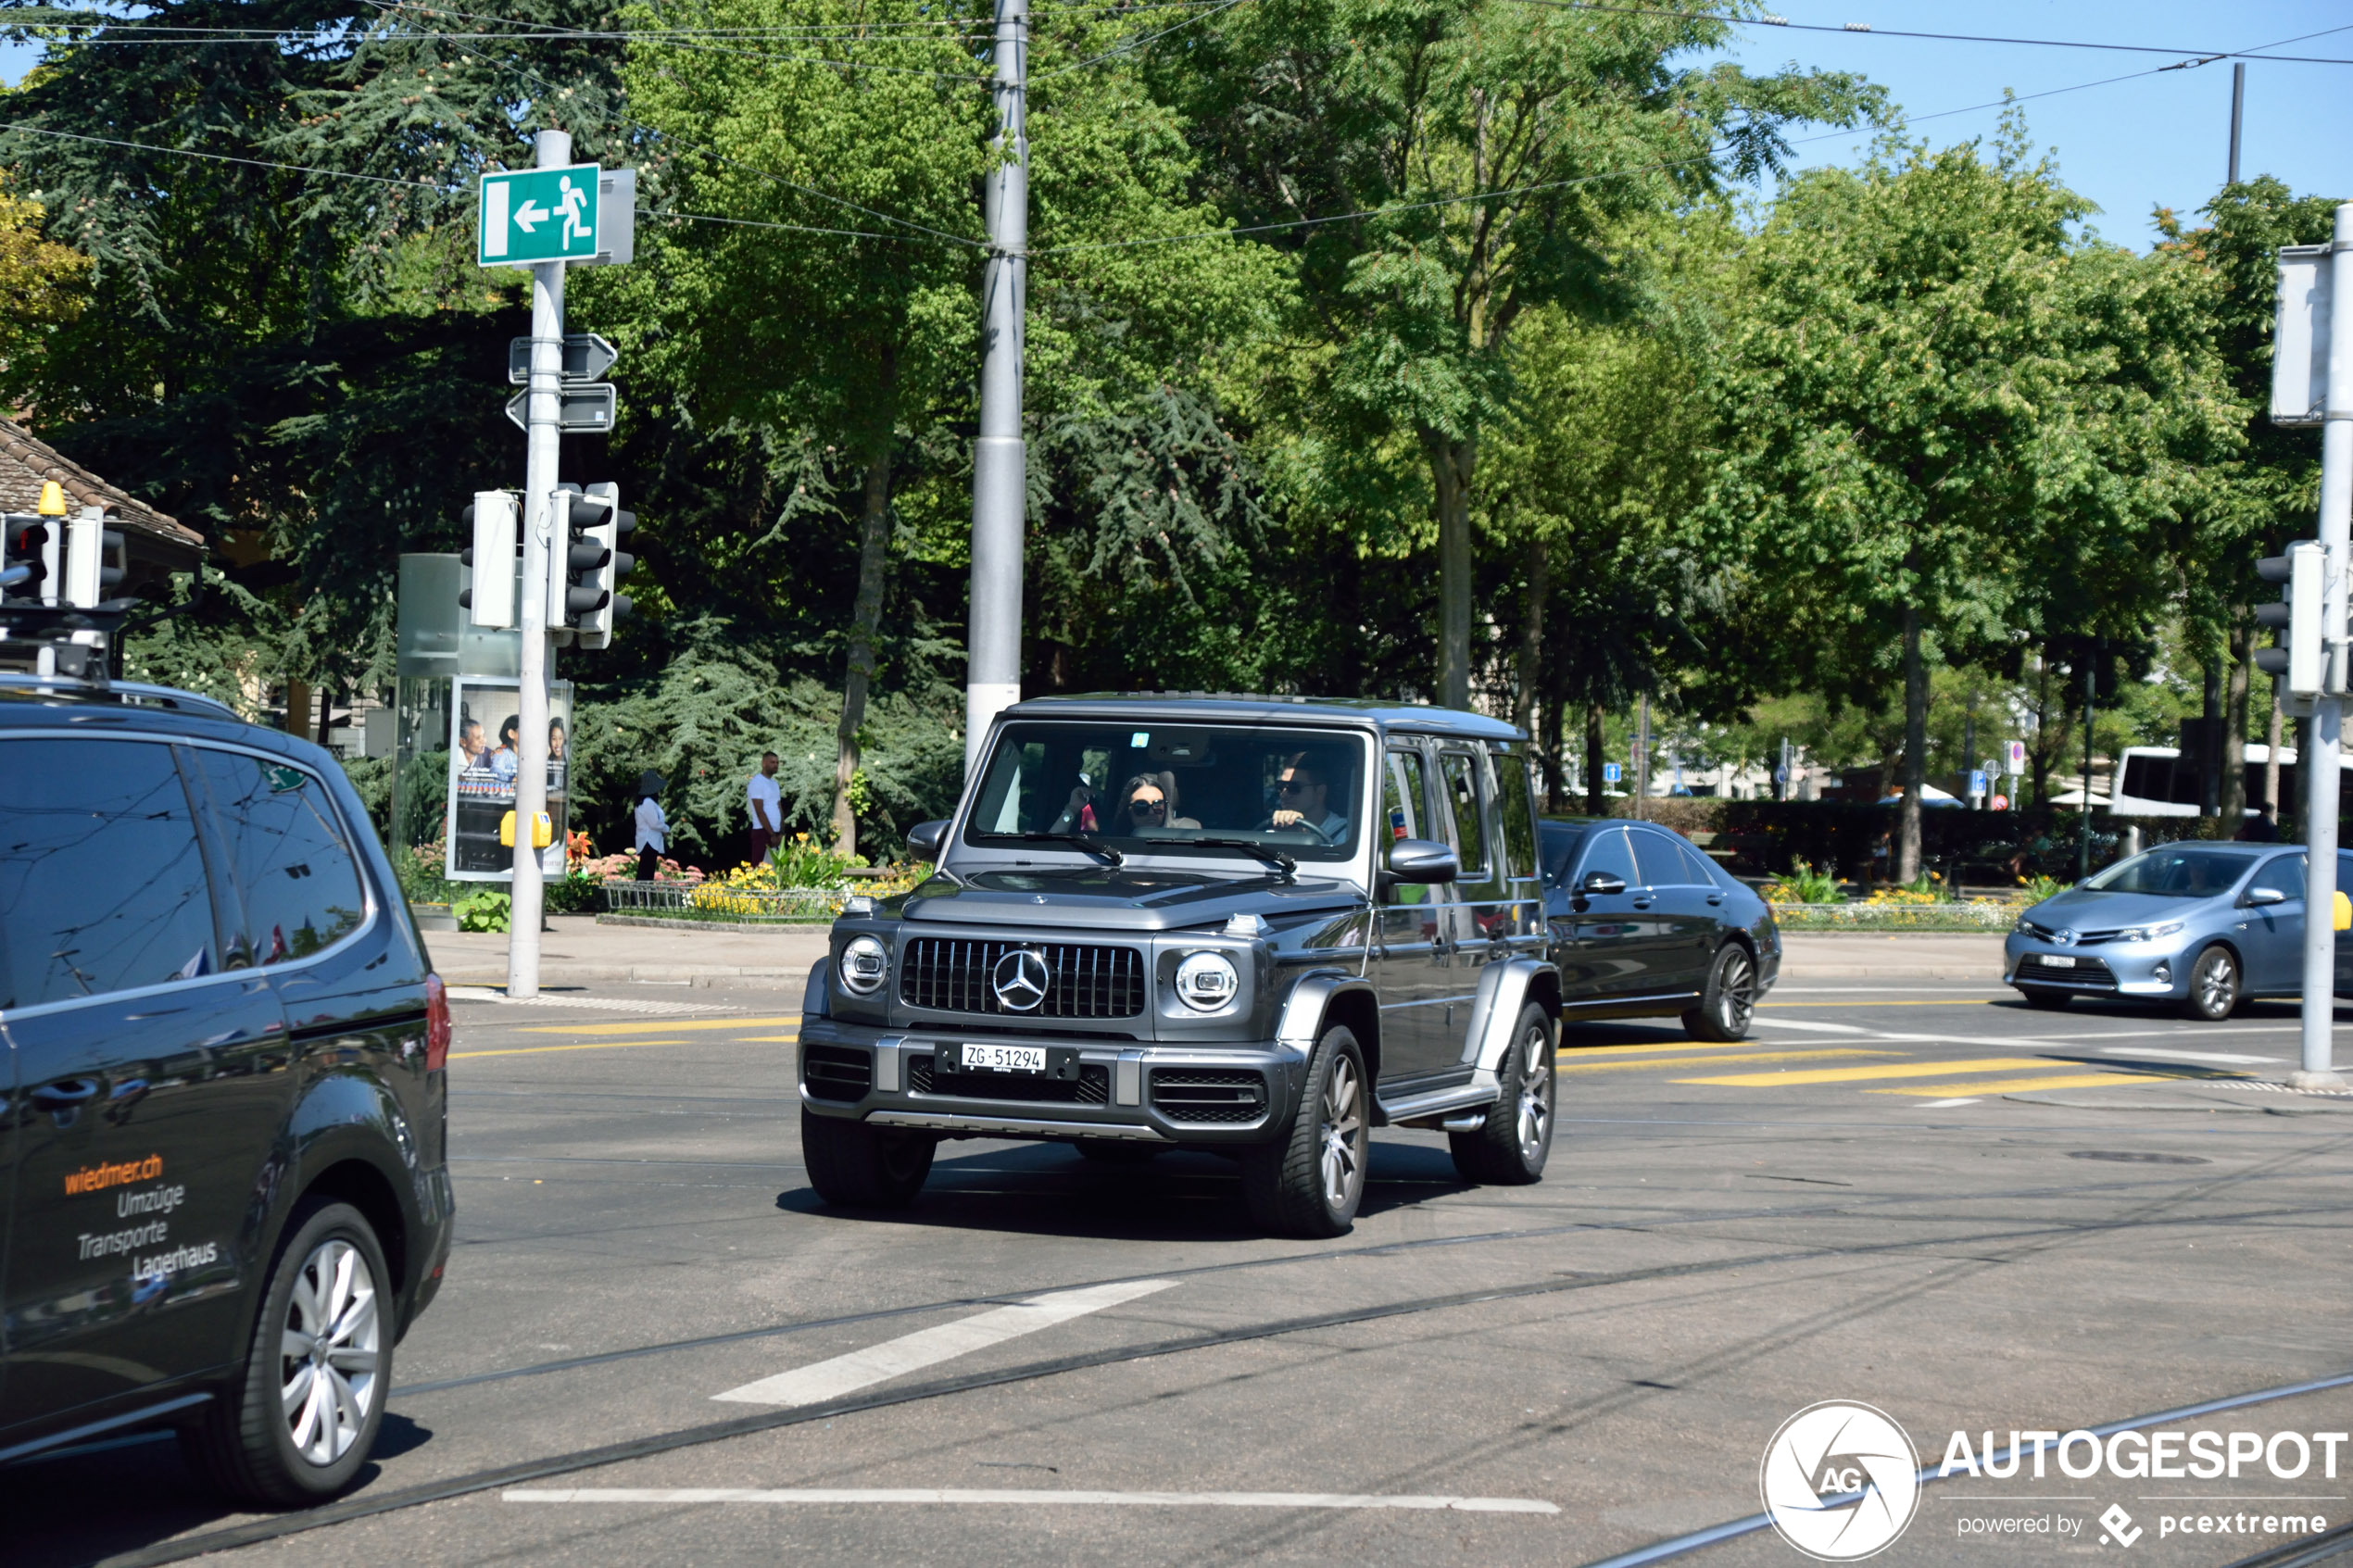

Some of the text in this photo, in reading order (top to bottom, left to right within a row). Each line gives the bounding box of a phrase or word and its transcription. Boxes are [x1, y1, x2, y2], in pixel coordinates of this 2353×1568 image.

[64, 1153, 163, 1196] wiedmer.ch
[117, 1184, 185, 1218] Umzüge
[77, 1220, 169, 1260] Transporte
[132, 1241, 219, 1282] Lagerhaus
